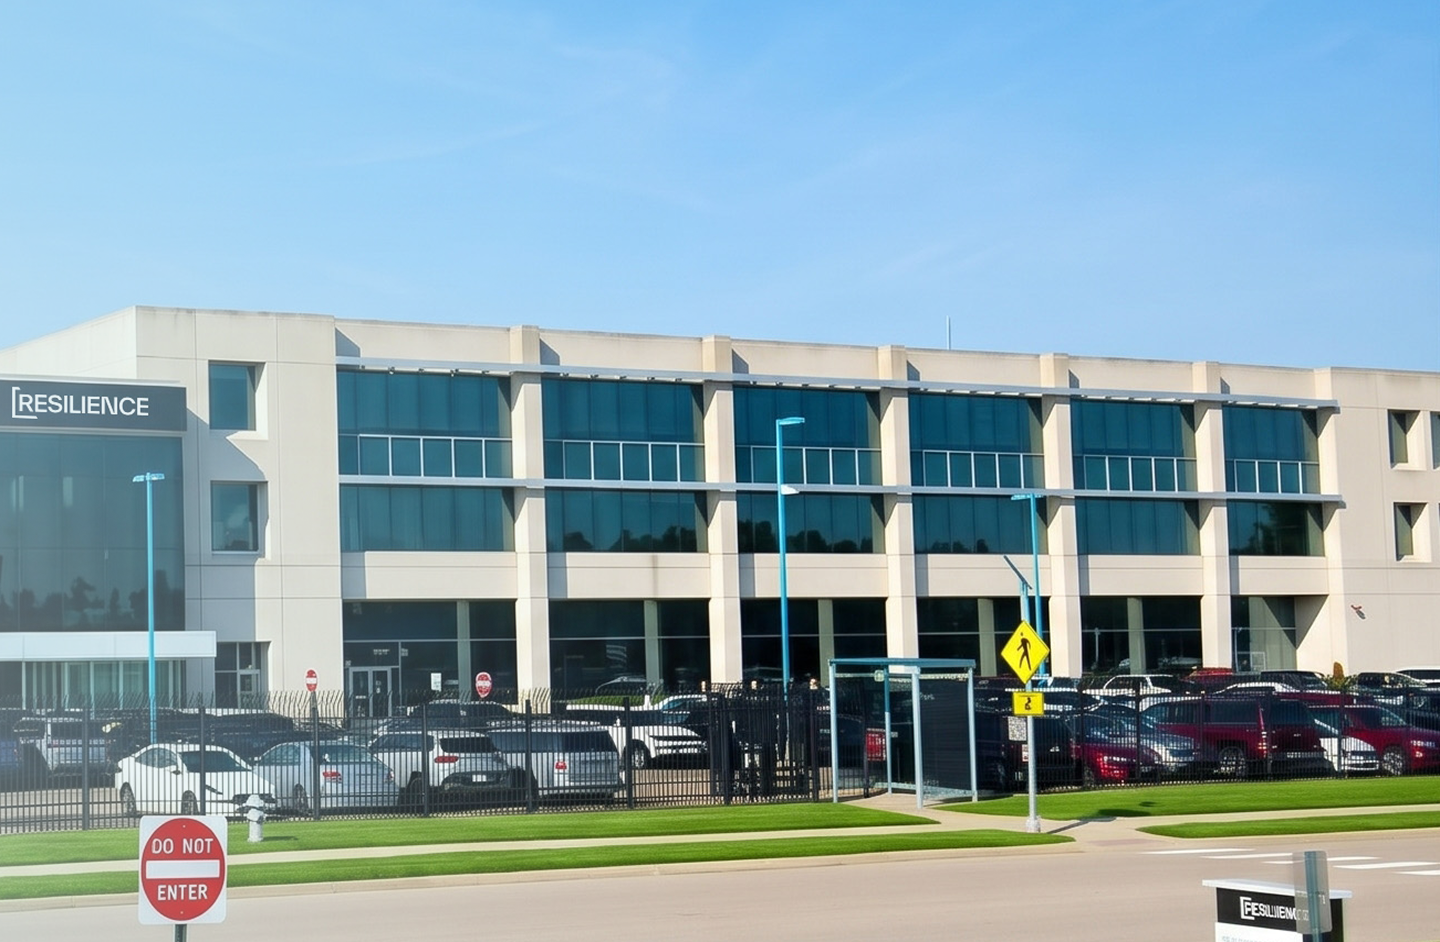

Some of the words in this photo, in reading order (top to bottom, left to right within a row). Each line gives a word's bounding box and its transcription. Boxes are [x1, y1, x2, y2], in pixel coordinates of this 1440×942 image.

[18, 393, 149, 416] RESILIENCE
[152, 838, 174, 854] DO
[182, 838, 214, 854] NOT
[157, 884, 208, 900] ENTER
